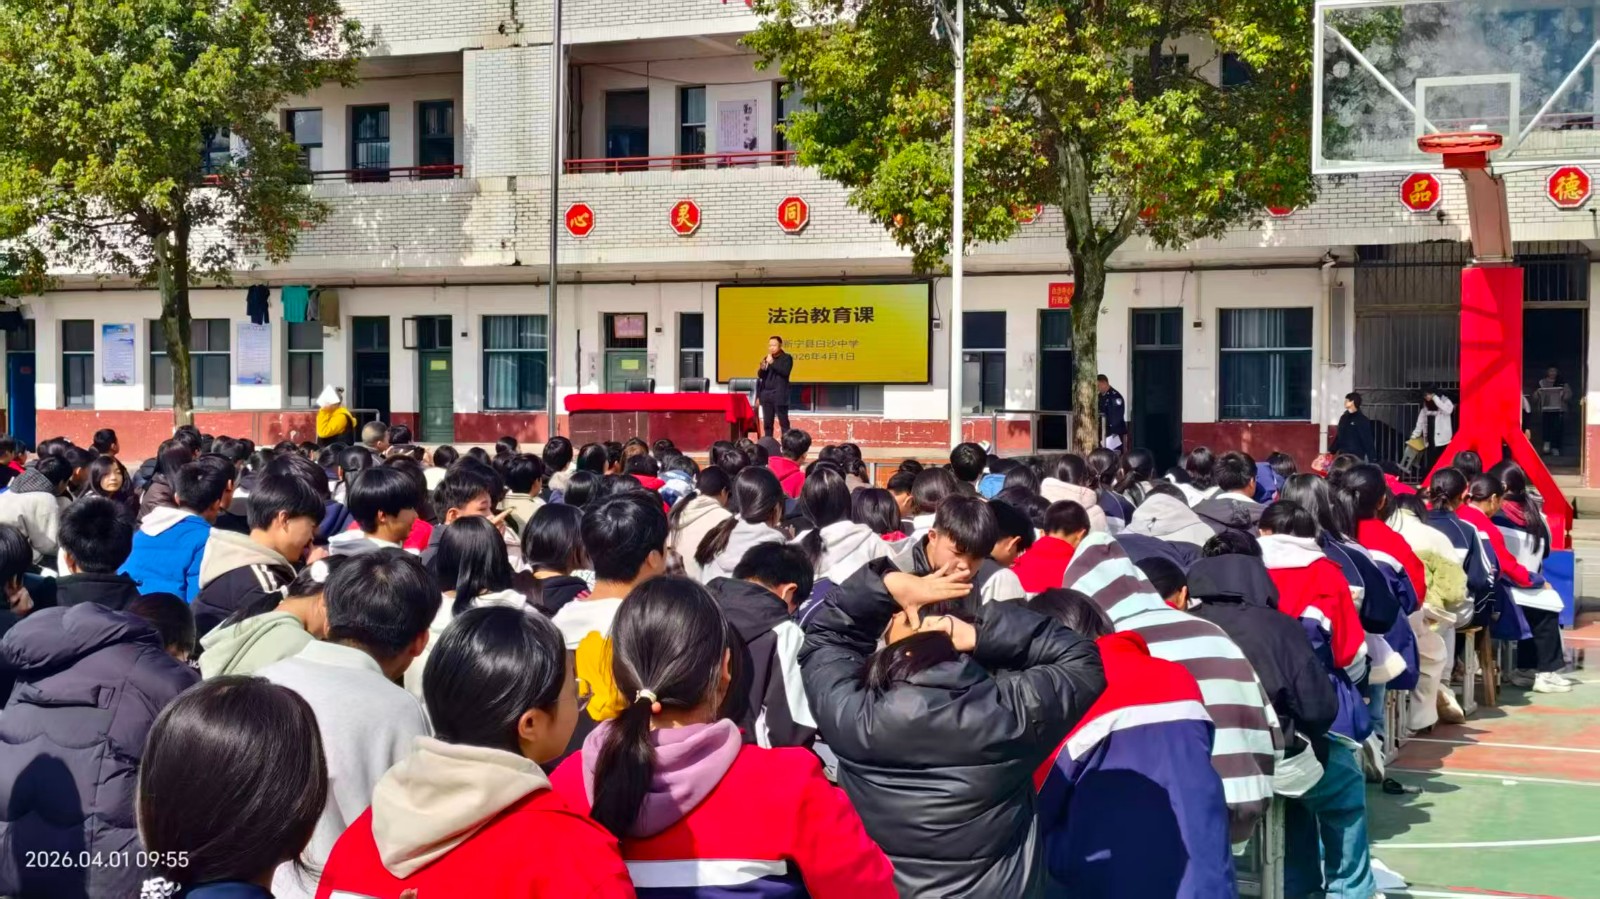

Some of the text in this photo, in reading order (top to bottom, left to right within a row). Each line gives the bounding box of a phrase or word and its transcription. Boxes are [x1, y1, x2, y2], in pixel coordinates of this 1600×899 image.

[1409, 179, 1432, 205] 品
[1554, 172, 1584, 201] 德
[570, 212, 590, 229] 心
[676, 204, 695, 228] 灵
[784, 201, 801, 225] 同
[767, 306, 875, 325] 法治教育课
[790, 352, 855, 361] 026年4月1日
